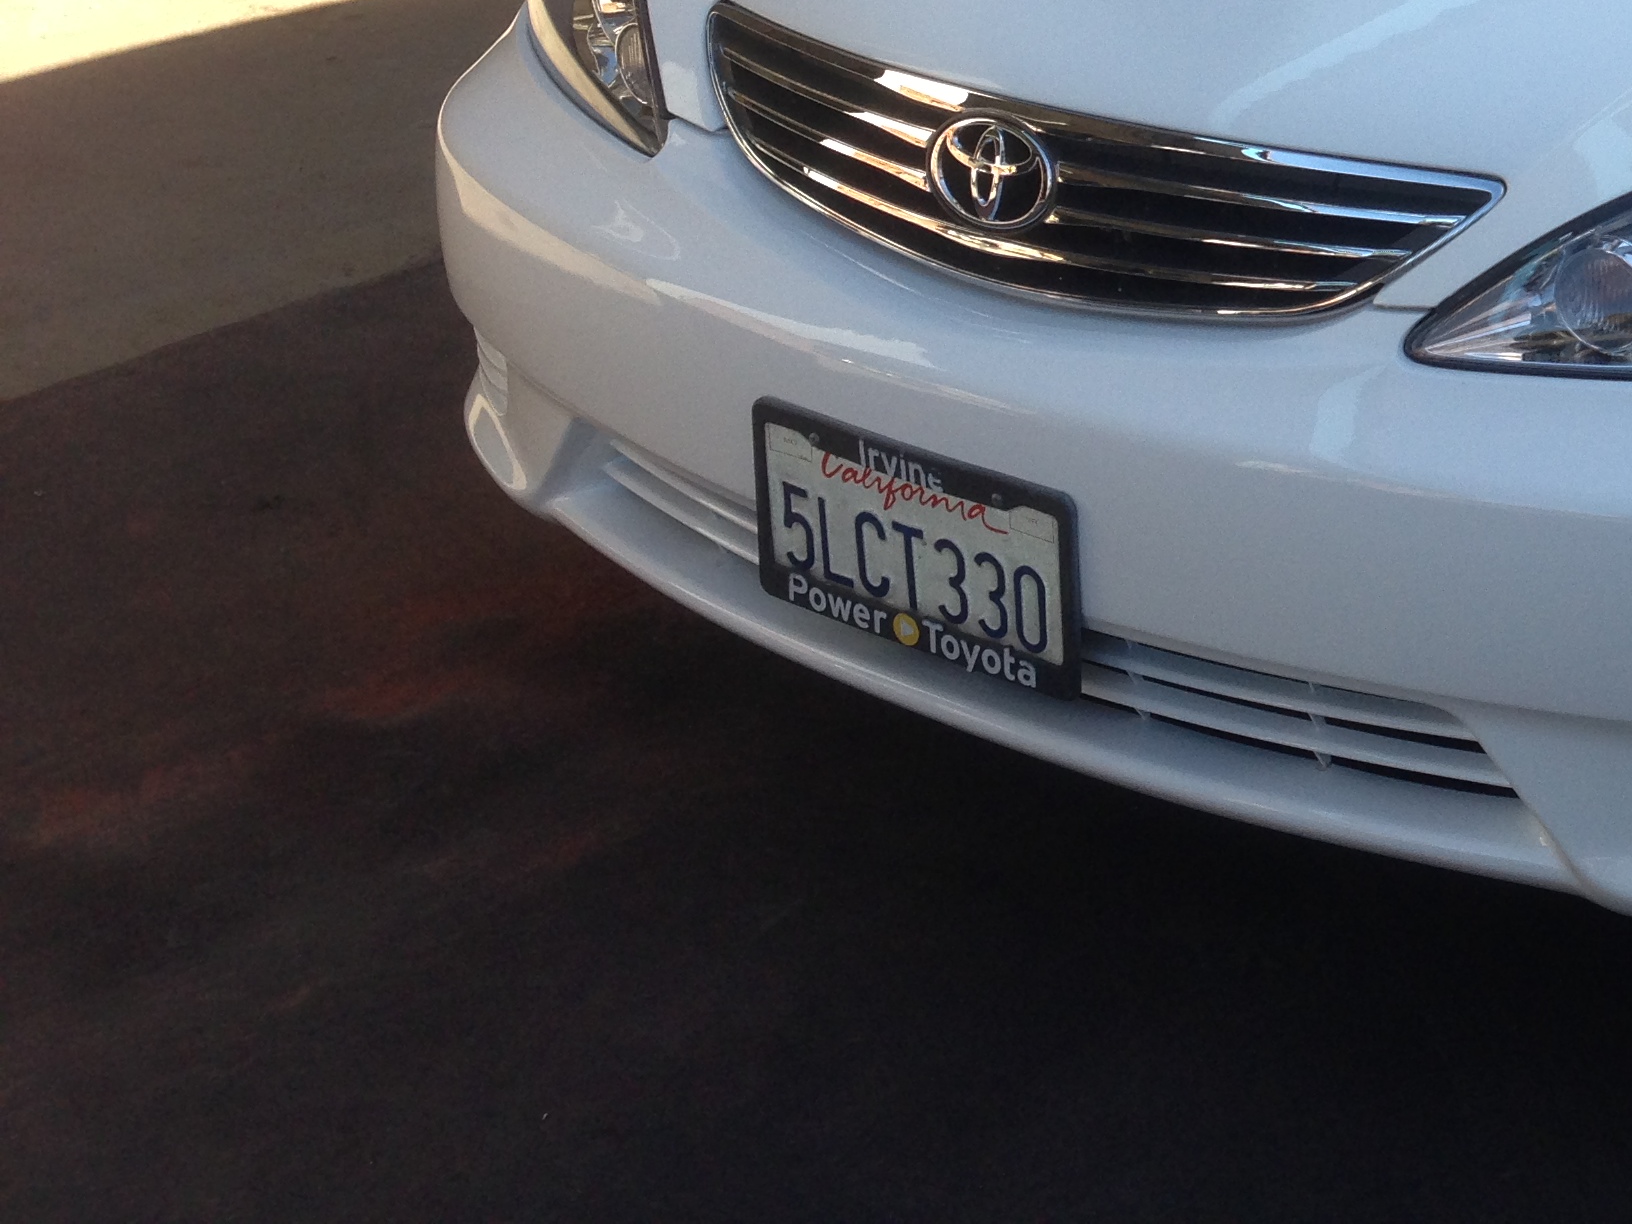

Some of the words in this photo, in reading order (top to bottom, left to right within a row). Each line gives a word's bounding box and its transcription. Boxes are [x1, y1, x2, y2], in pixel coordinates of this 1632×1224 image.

[821, 451, 1008, 535] California
[858, 439, 944, 493] Irvine
[782, 480, 1048, 654] 5LCT330
[787, 573, 887, 634] Power
[921, 618, 1037, 688] Toyota
